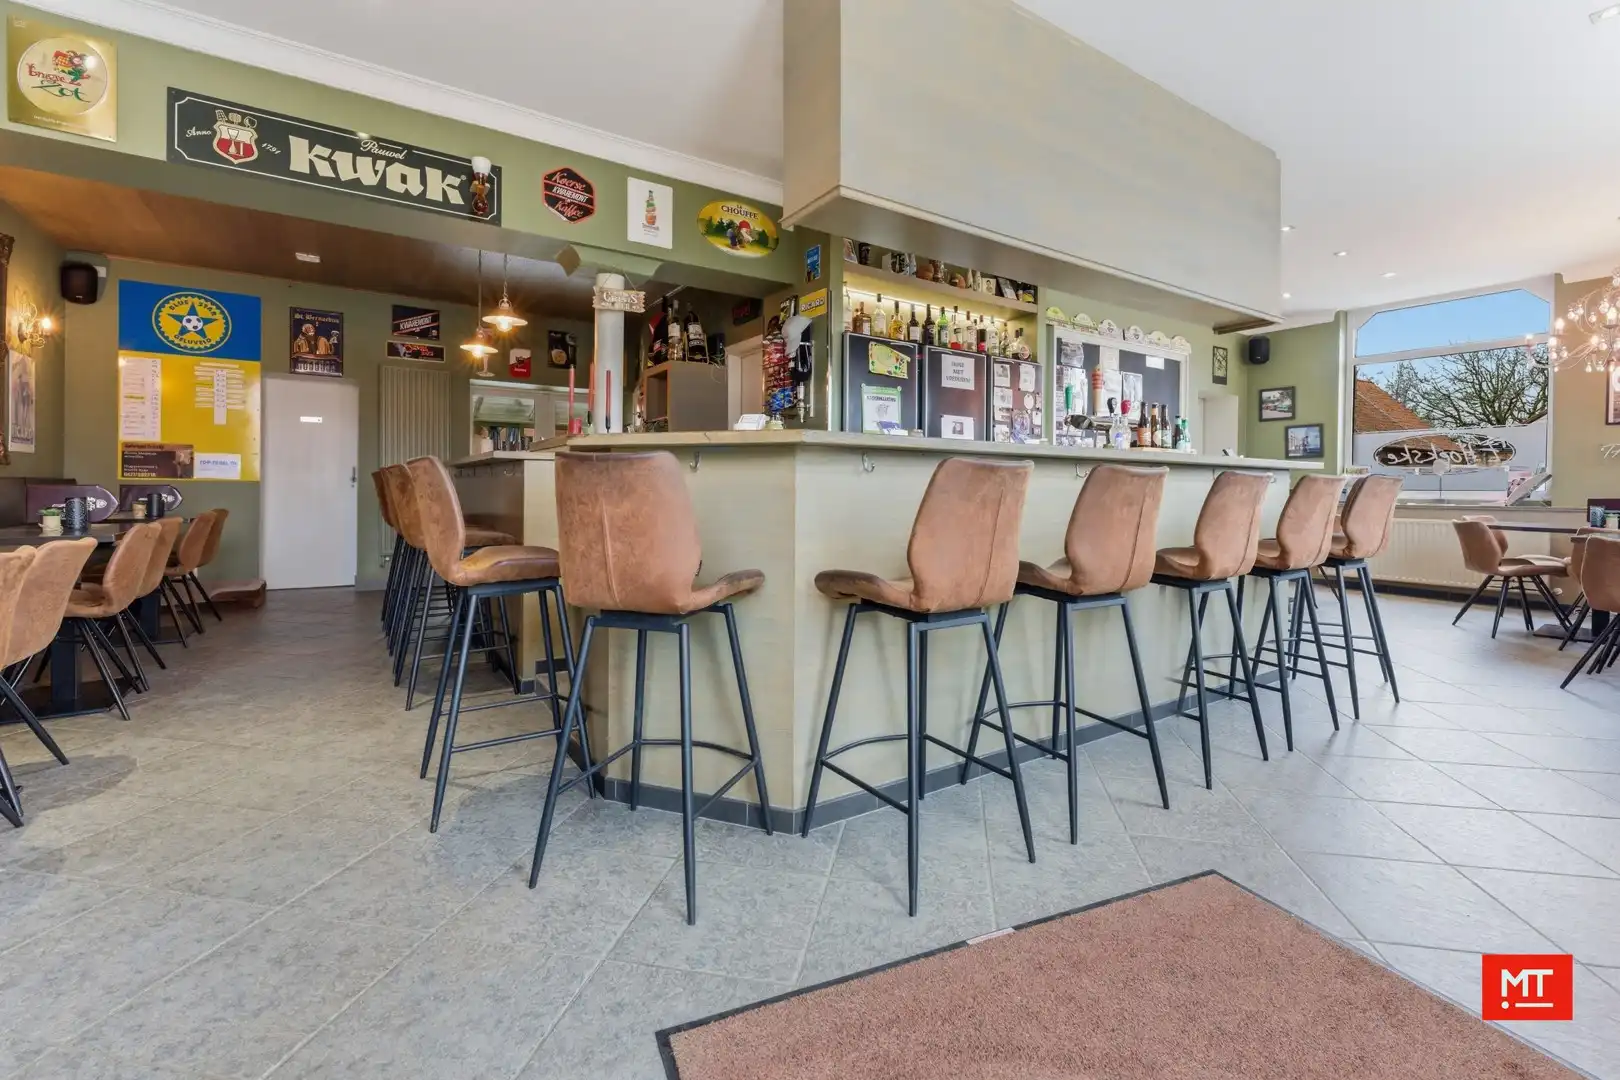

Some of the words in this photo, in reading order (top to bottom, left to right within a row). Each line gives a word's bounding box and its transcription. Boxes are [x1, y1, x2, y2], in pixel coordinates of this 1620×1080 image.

[186, 126, 212, 138] Anno
[360, 140, 407, 160] Pauwel
[552, 186, 589, 203] KWAREMONT
[721, 205, 759, 220] CHOUFFE
[169, 300, 189, 311] BLUE
[198, 301, 217, 317] STAR
[800, 297, 825, 312] RICARD
[399, 316, 432, 330] KWAREMONT
[174, 334, 212, 345] GELUVELD
